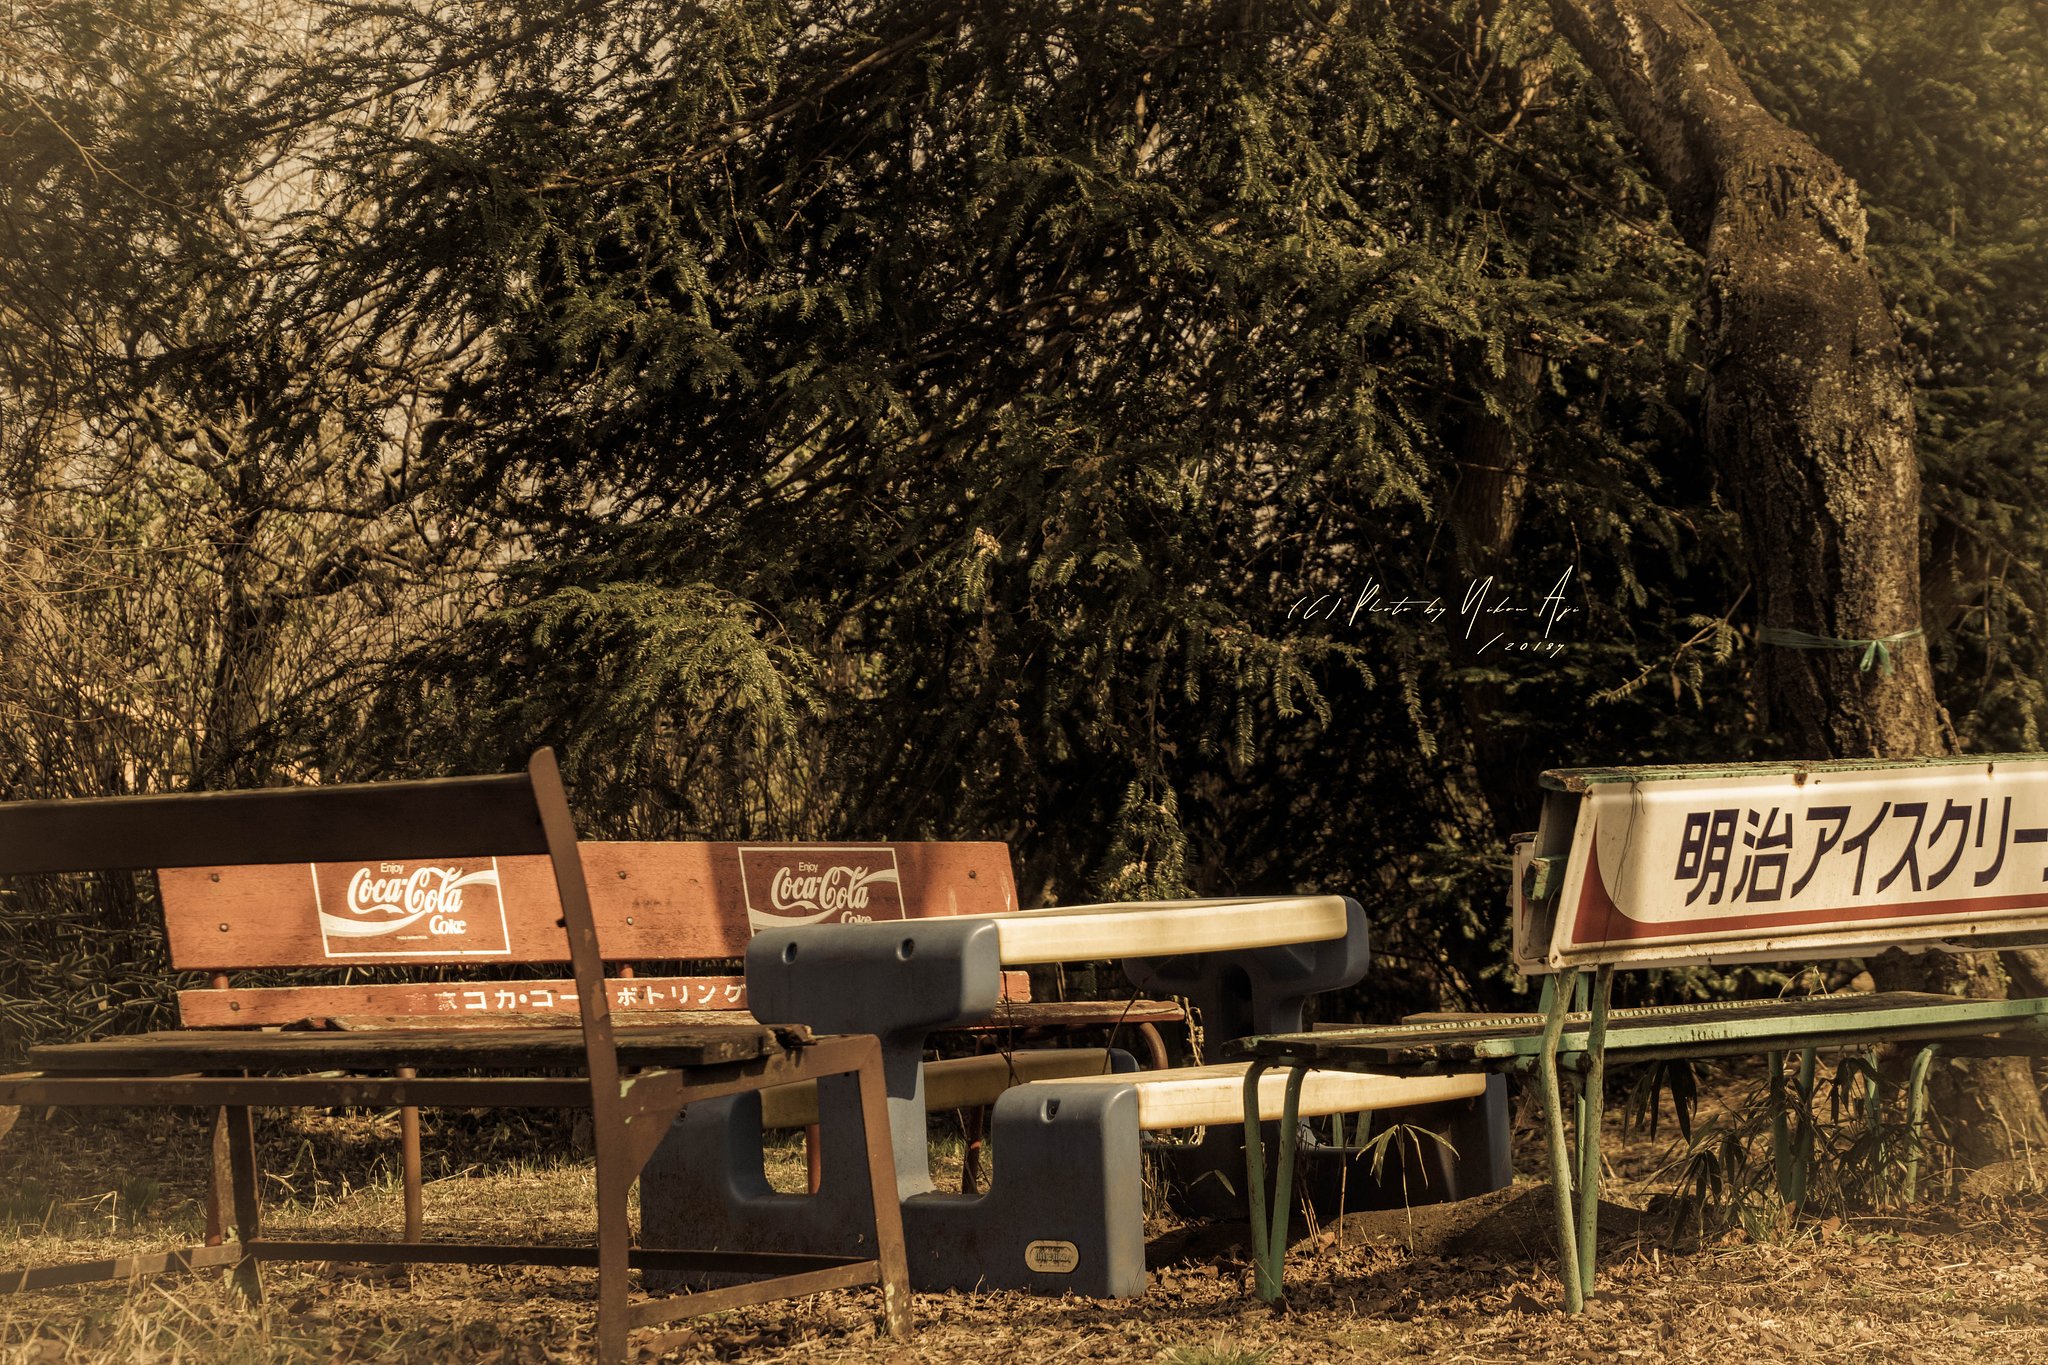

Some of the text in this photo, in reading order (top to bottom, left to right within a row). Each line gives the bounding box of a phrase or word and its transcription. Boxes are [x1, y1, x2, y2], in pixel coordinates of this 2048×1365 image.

[1674, 796, 2048, 906] 明治アイスクリー
[381, 863, 404, 874] Enjoy
[798, 862, 818, 872] Enjoy
[347, 867, 463, 914] Coca-Cola
[771, 866, 869, 910] Coca-Cola
[429, 915, 466, 934] Coke
